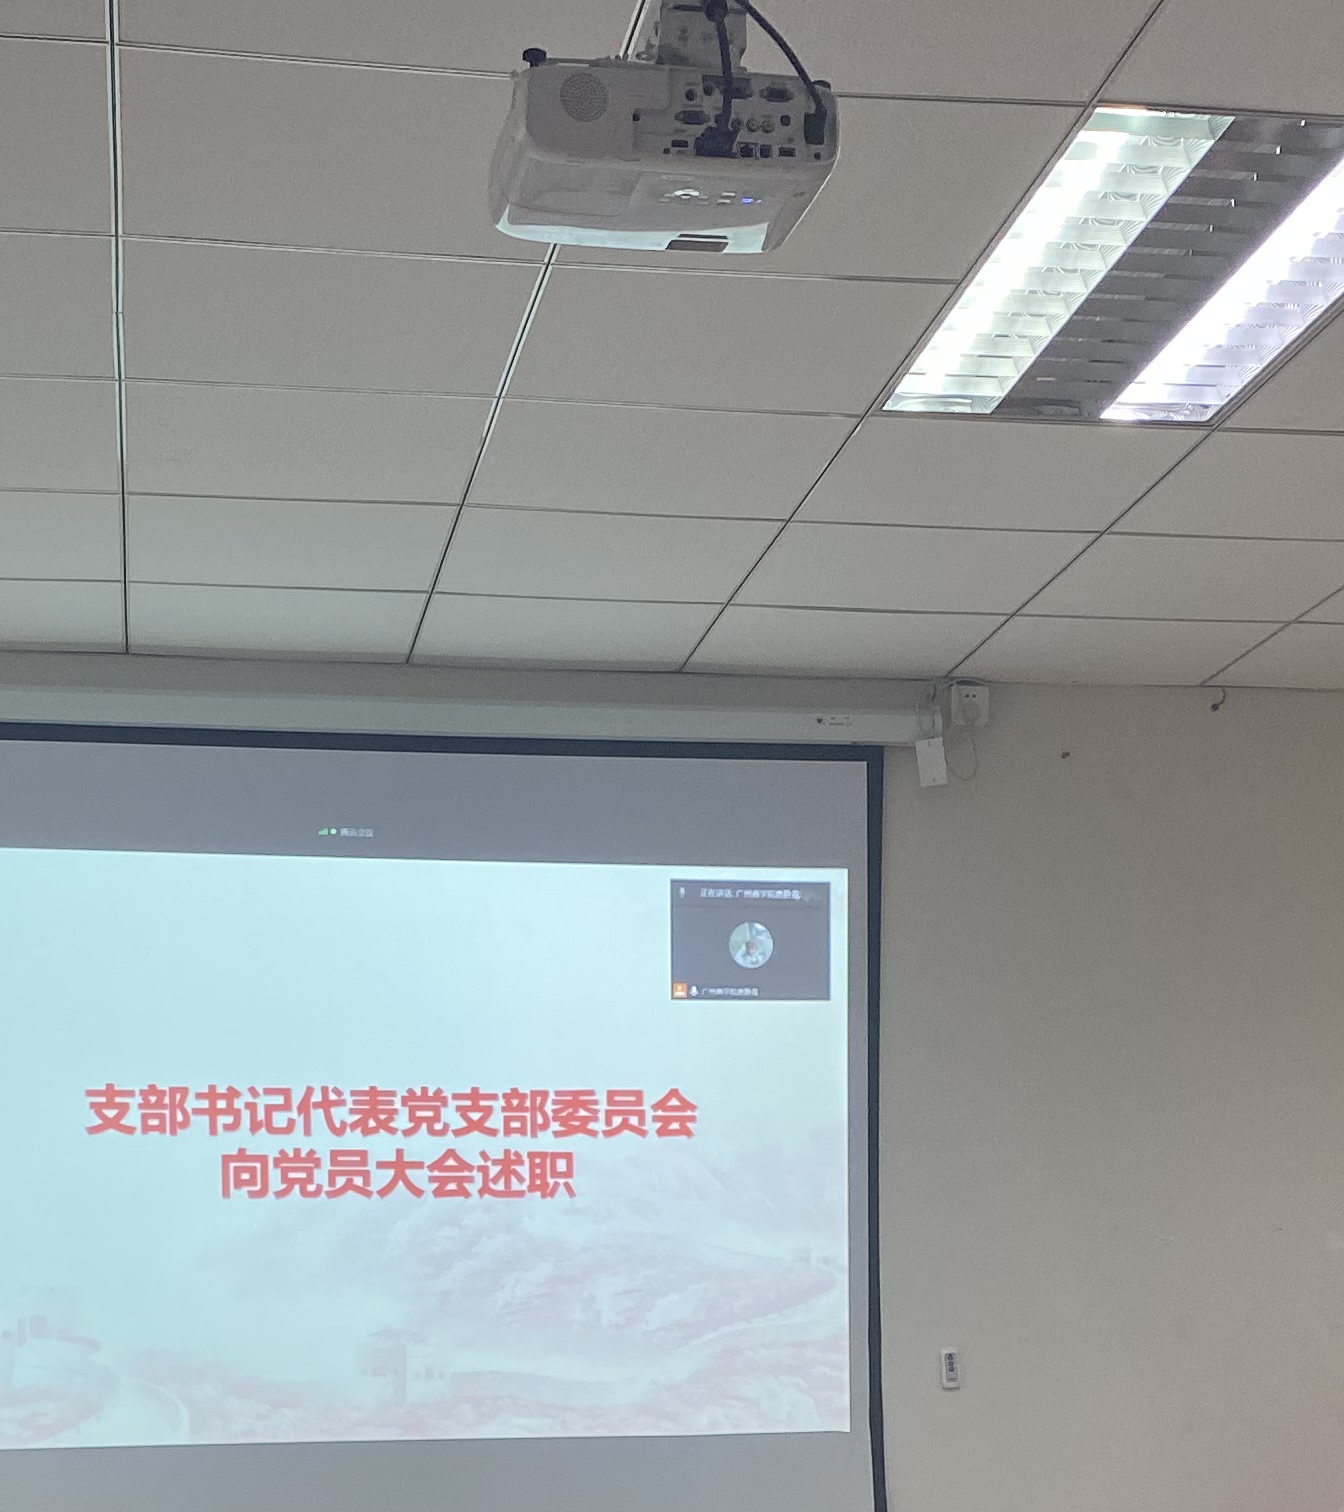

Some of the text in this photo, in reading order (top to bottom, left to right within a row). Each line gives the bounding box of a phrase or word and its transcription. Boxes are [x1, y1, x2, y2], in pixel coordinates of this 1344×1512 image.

[84, 1083, 698, 1138] 支部书记代表党支部委员会
[220, 1147, 576, 1199] 向党员大会述职
